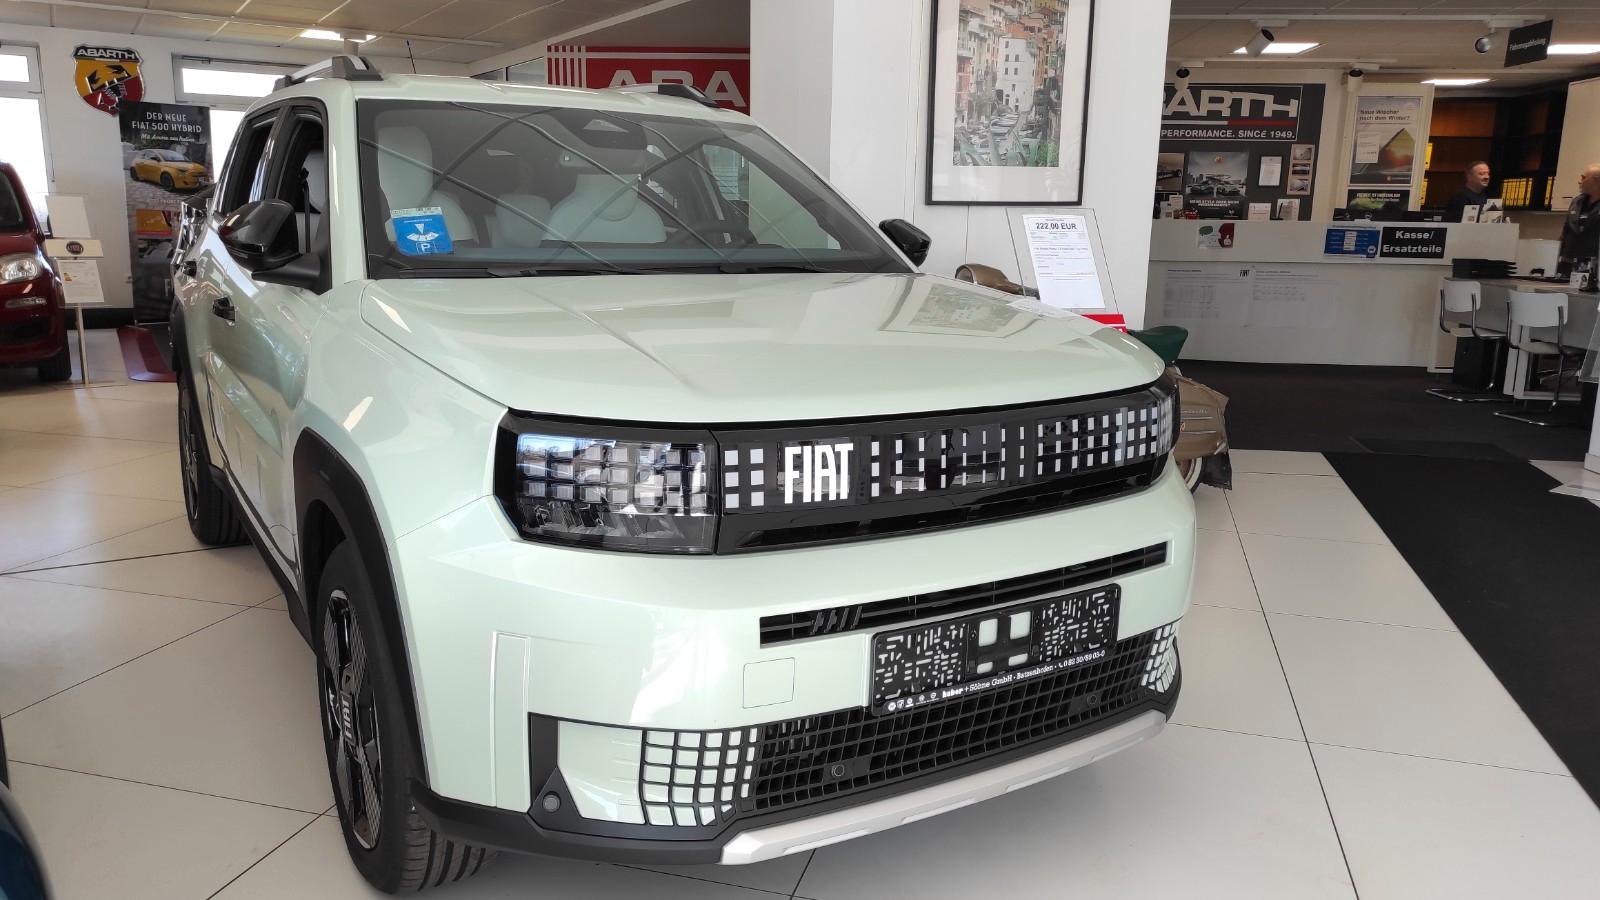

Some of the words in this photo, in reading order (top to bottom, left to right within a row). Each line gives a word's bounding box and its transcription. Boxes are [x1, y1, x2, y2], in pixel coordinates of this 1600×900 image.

[77, 48, 135, 59] ABARTH
[1163, 88, 1298, 118] ARTH
[146, 112, 163, 120] DER
[165, 113, 187, 121] NEUE
[132, 121, 150, 129] FIAT
[151, 122, 169, 131] 500
[171, 124, 202, 133] HYBRID
[1161, 129, 1235, 138] PERFORMANCE.
[1238, 130, 1267, 138] SINCE
[1270, 131, 1295, 139] 1949.
[1036, 222, 1059, 230] 222,00
[1395, 230, 1433, 240] Kasse/
[421, 243, 430, 252] P
[1382, 244, 1442, 253] Ersatzteile
[784, 443, 853, 504] FIAT
[969, 681, 991, 692] Söhne
[991, 674, 1013, 686] GmbH
[341, 695, 353, 739] FIAT
